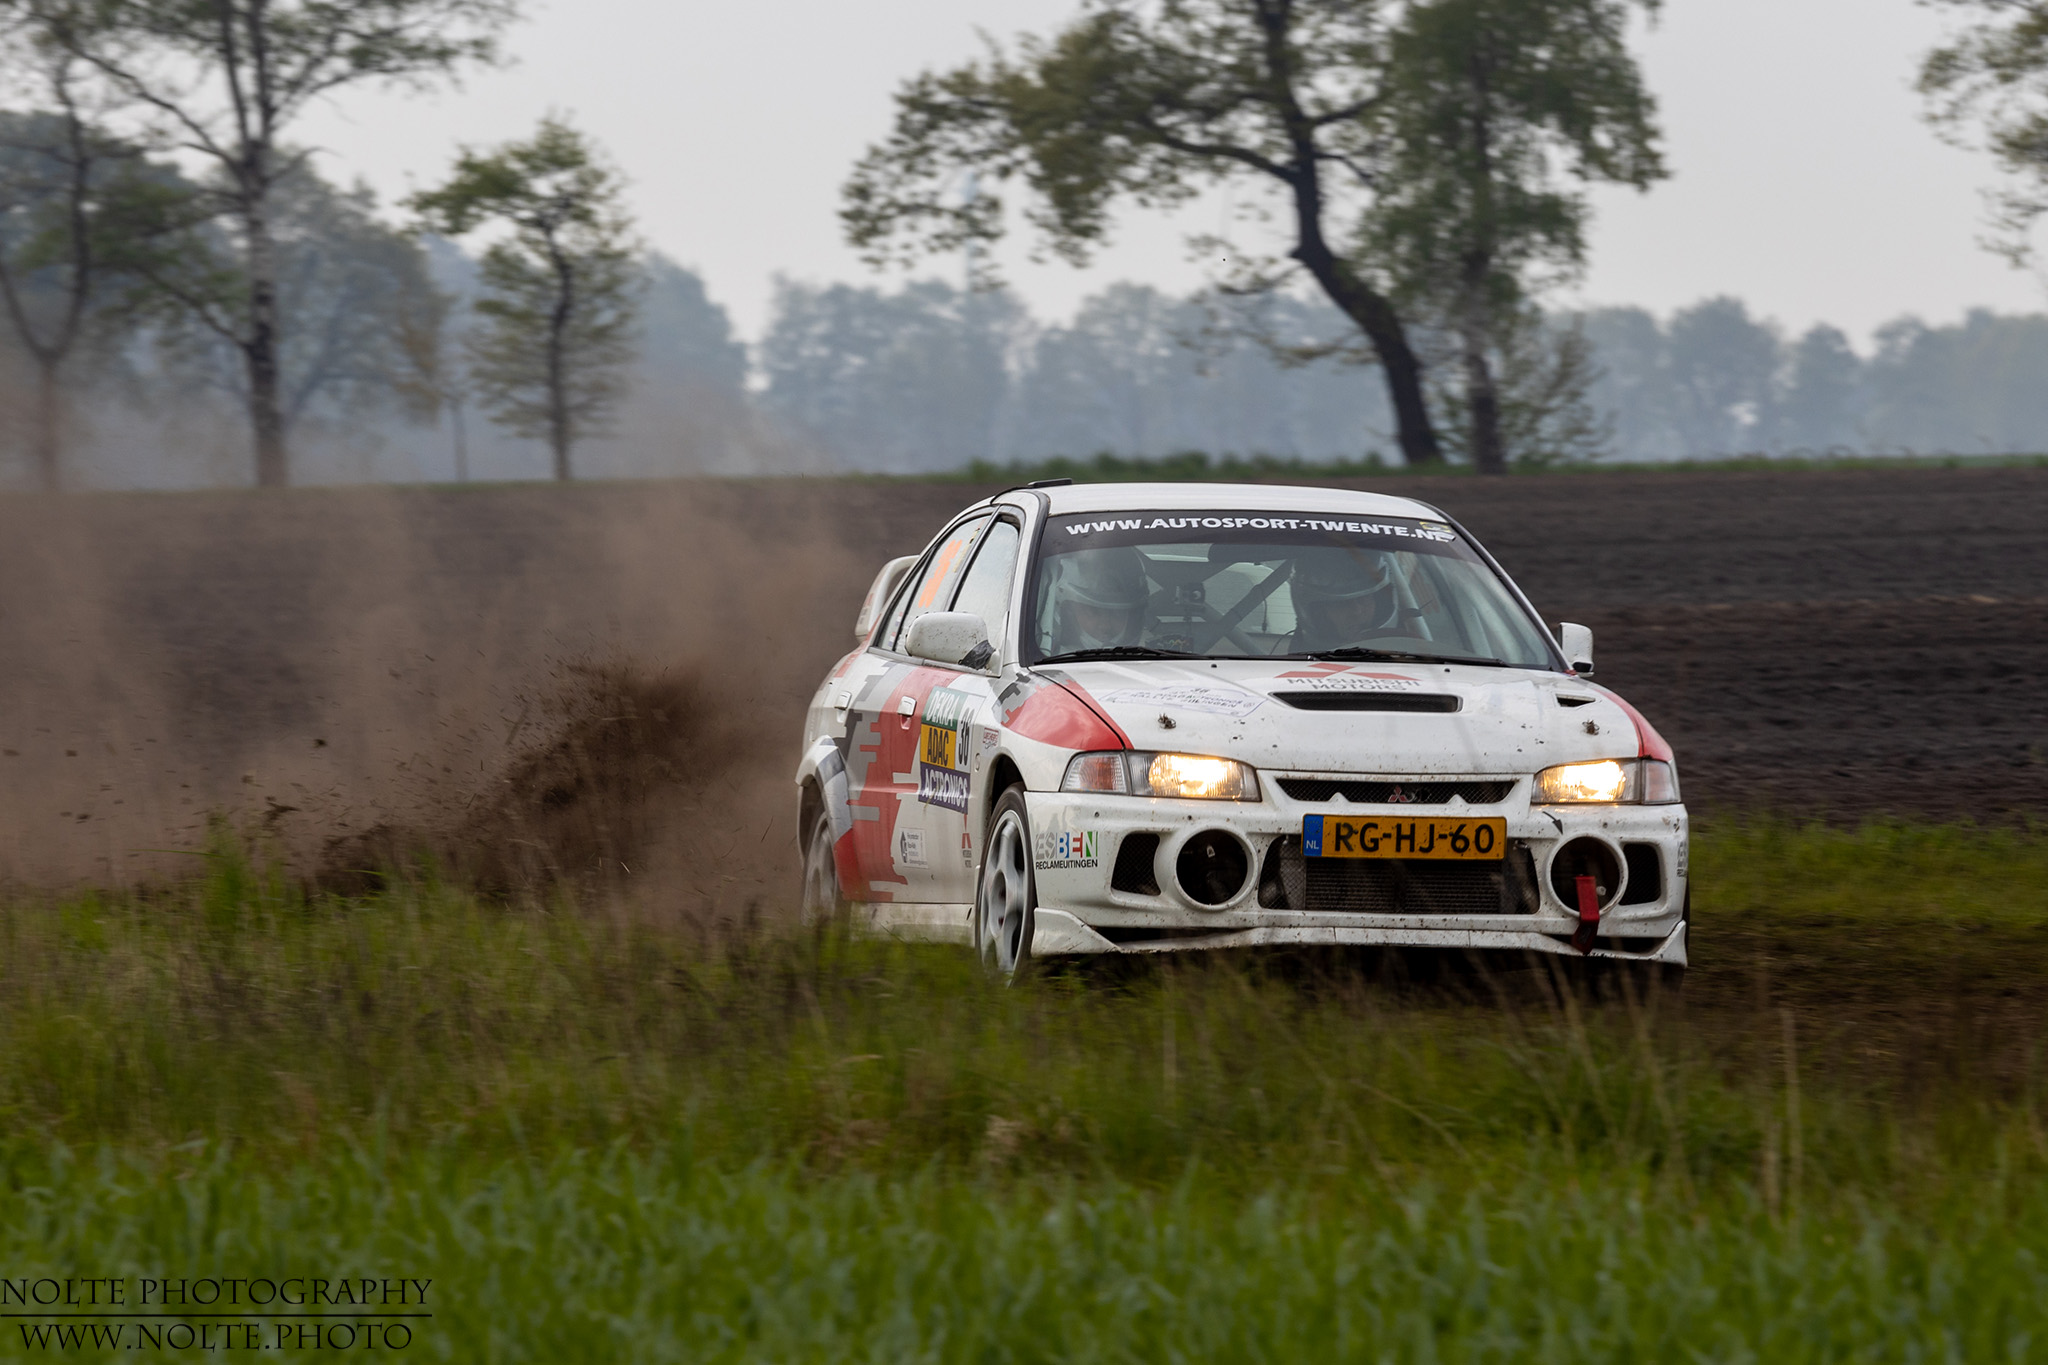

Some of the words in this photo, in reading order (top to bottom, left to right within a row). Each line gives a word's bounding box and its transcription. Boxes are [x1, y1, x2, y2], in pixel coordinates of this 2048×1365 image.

[1287, 678, 1421, 687] MITSUBISHI
[926, 690, 960, 727] DEKRA
[927, 727, 949, 767] ADAC
[922, 768, 968, 808] ACTRONICS
[1305, 840, 1320, 850] NL
[1335, 822, 1495, 854] RG-HJ-60
[1035, 859, 1098, 870] RECLAMEUITINGEN
